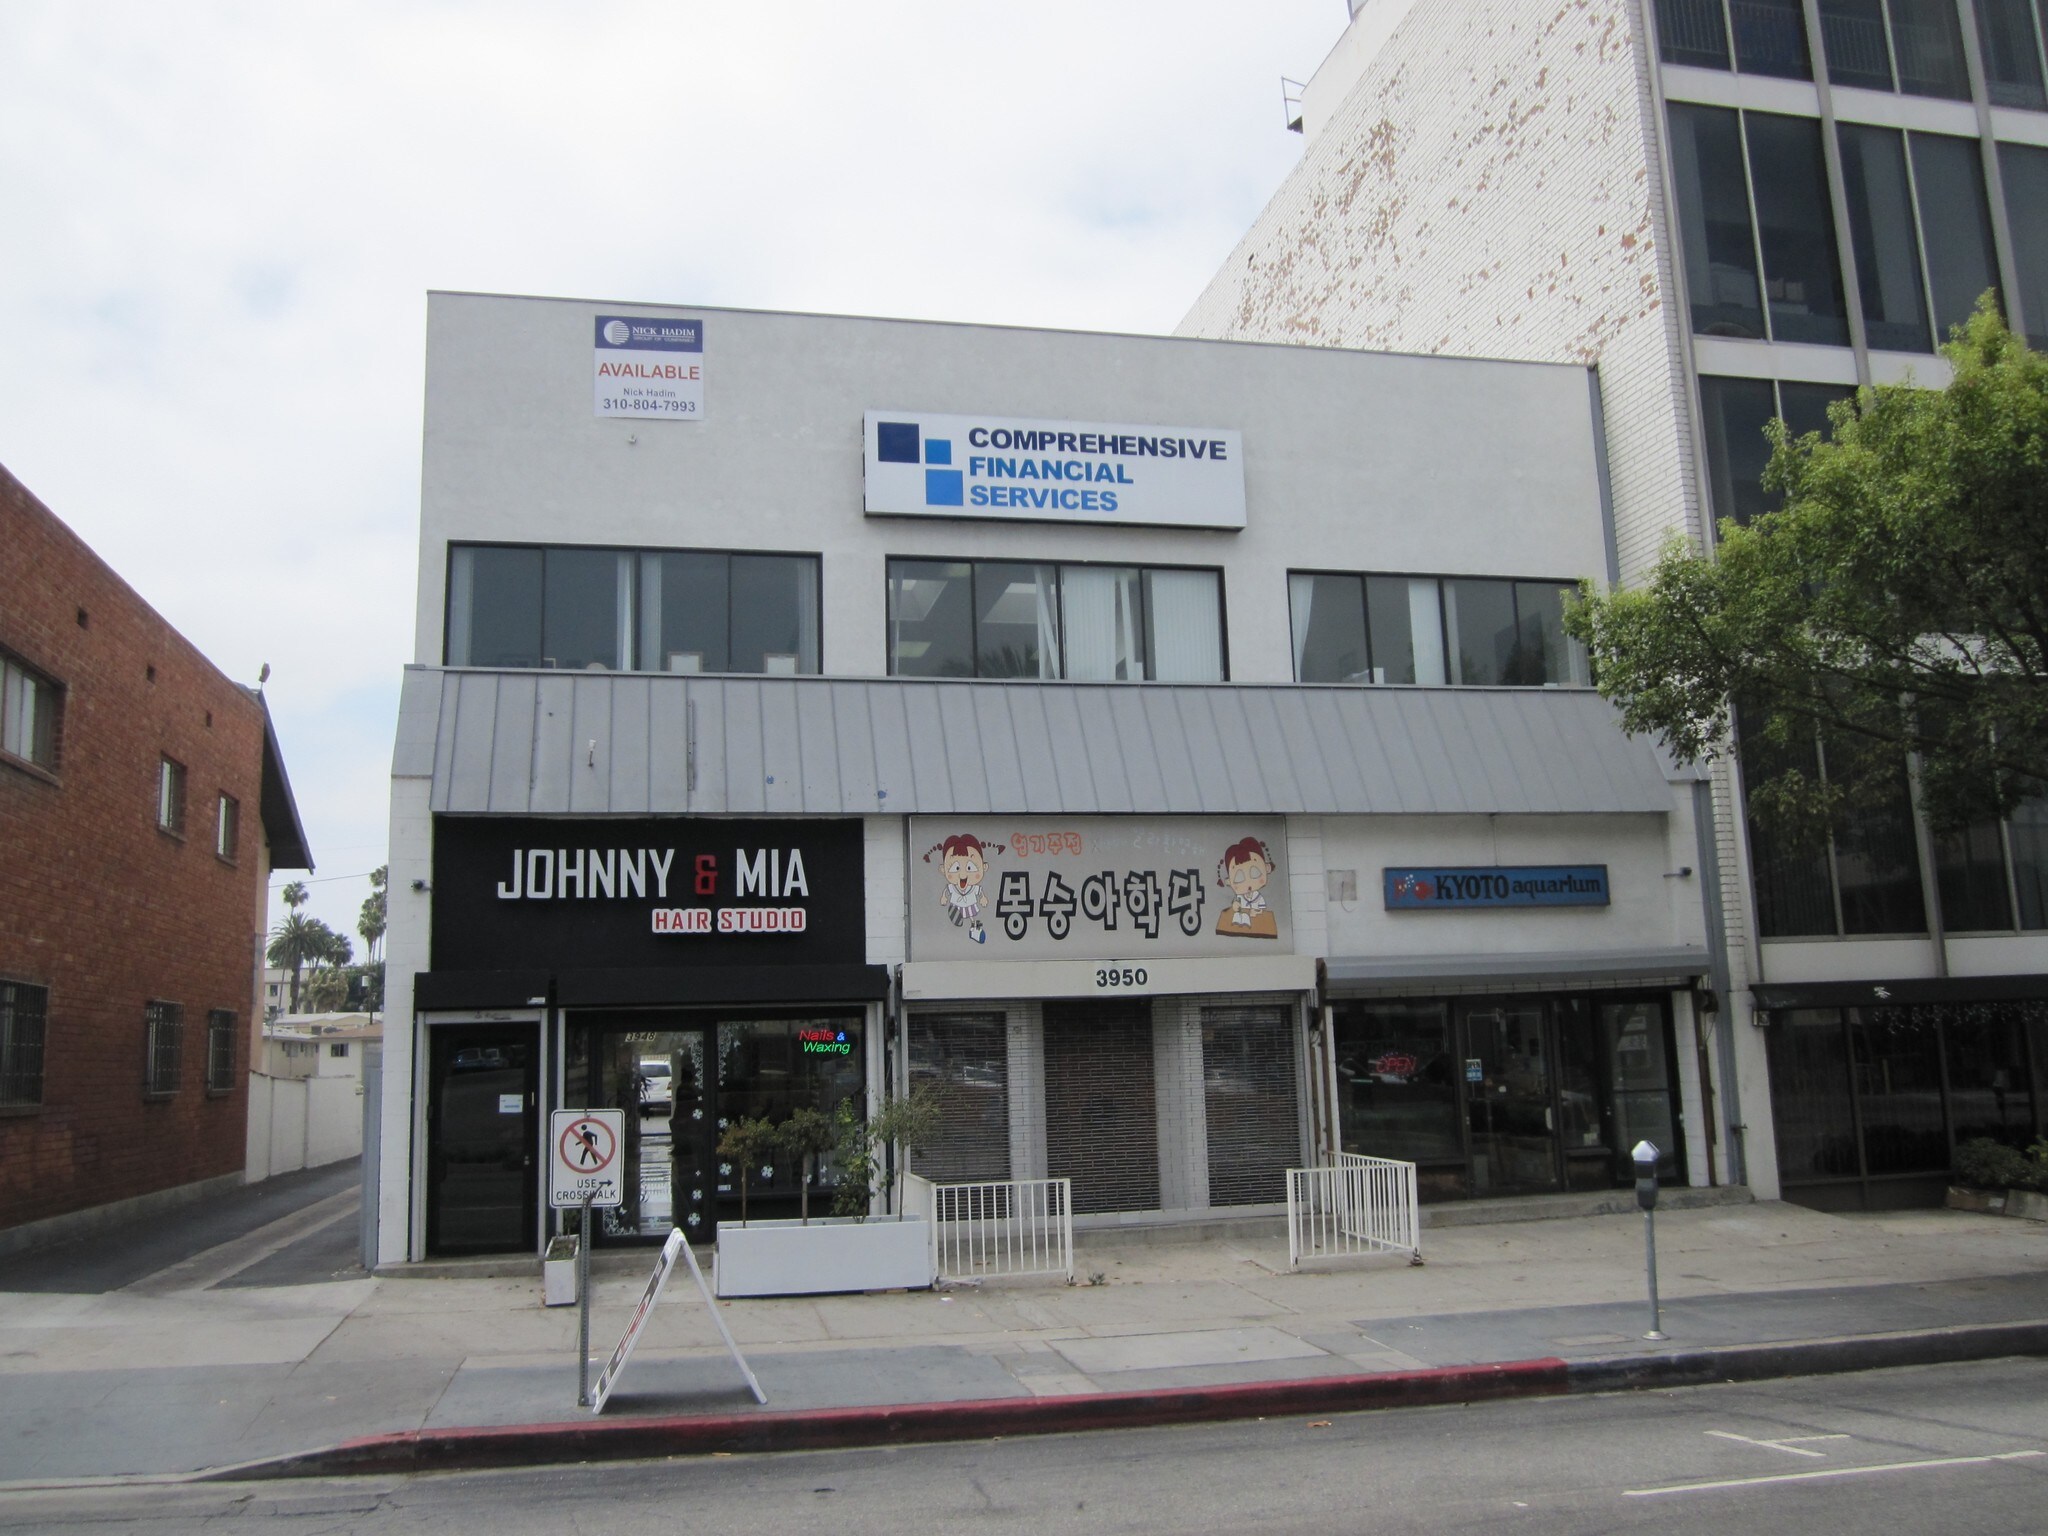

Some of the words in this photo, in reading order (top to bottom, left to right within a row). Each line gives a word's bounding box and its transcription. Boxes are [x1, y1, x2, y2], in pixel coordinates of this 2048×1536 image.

[632, 326, 657, 335] NICK
[661, 327, 695, 336] HADIM
[598, 362, 700, 380] AVAILABLE
[623, 387, 644, 396] Nick
[646, 389, 676, 398] Hadim
[603, 398, 696, 412] 310-804-7993
[968, 427, 1227, 460] COMPREHENSIVE
[969, 456, 1134, 484] FINANCIAL
[970, 485, 1118, 512] SERVICES
[498, 848, 675, 899] JOHNNY
[694, 854, 718, 895] &
[736, 848, 809, 897] MIA
[1434, 875, 1510, 900] KYOTO
[1512, 874, 1601, 898] aquarium
[996, 868, 1206, 941] 봉숭아학당
[653, 910, 710, 932] HAIR
[719, 909, 805, 931] STUDIO
[1096, 968, 1148, 987] 3950
[624, 1031, 656, 1041] 3948
[799, 1030, 835, 1041] Nails
[836, 1031, 845, 1041] &
[803, 1041, 851, 1055] Waxing
[1376, 1057, 1416, 1074] OPEN
[576, 1179, 597, 1188] USE
[556, 1190, 616, 1201] CROSSWALK
